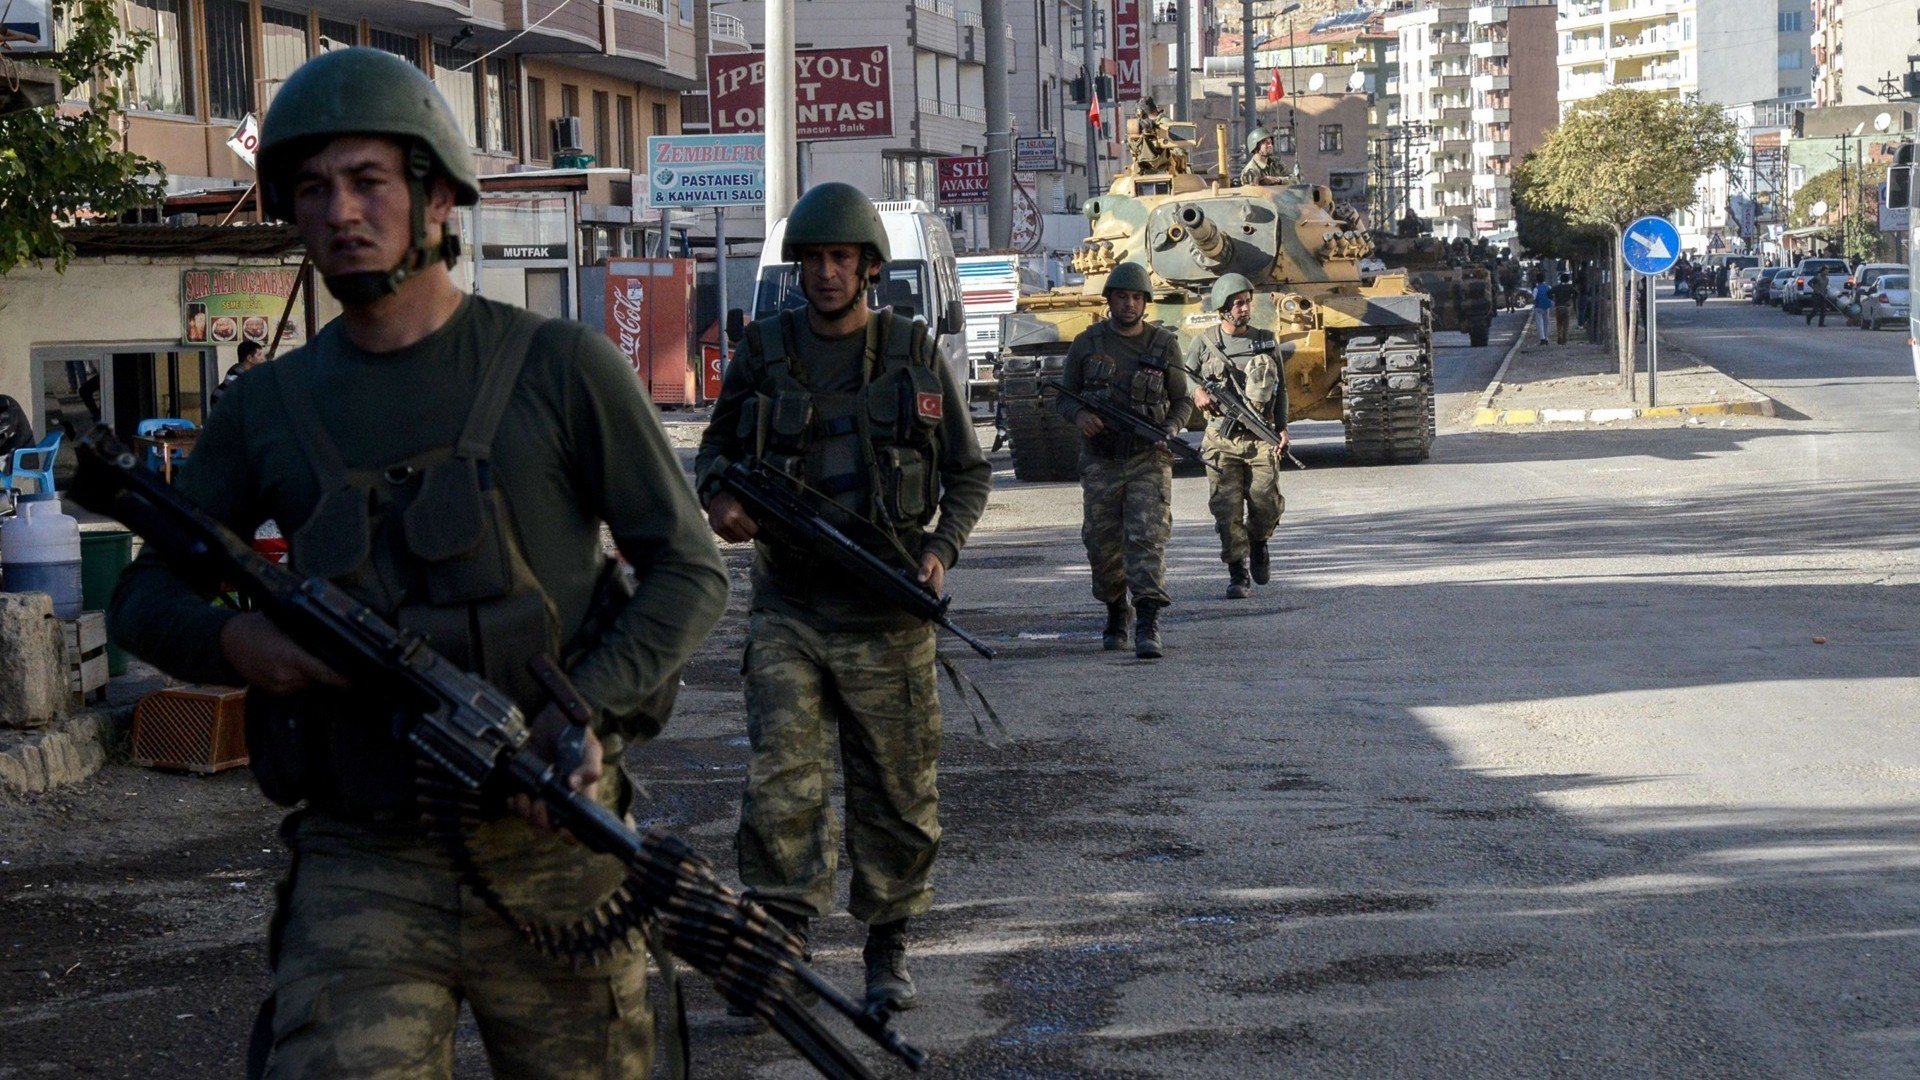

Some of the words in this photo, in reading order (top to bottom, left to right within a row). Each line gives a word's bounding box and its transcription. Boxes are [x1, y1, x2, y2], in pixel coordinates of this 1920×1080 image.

[716, 60, 766, 98] İPE
[797, 56, 881, 88] YOLU
[718, 101, 884, 128] LONTASI
[840, 123, 865, 133] Balık
[655, 141, 766, 163] ZEMBİLFRO
[681, 171, 754, 187] PASTANESİ
[655, 191, 665, 202] &
[668, 191, 728, 202] KAHVALTI
[731, 190, 766, 201] SALO
[503, 247, 550, 258] MUTFAK
[186, 271, 211, 301] SUR
[212, 271, 238, 295] ALTI
[614, 286, 641, 373] ca-Col
